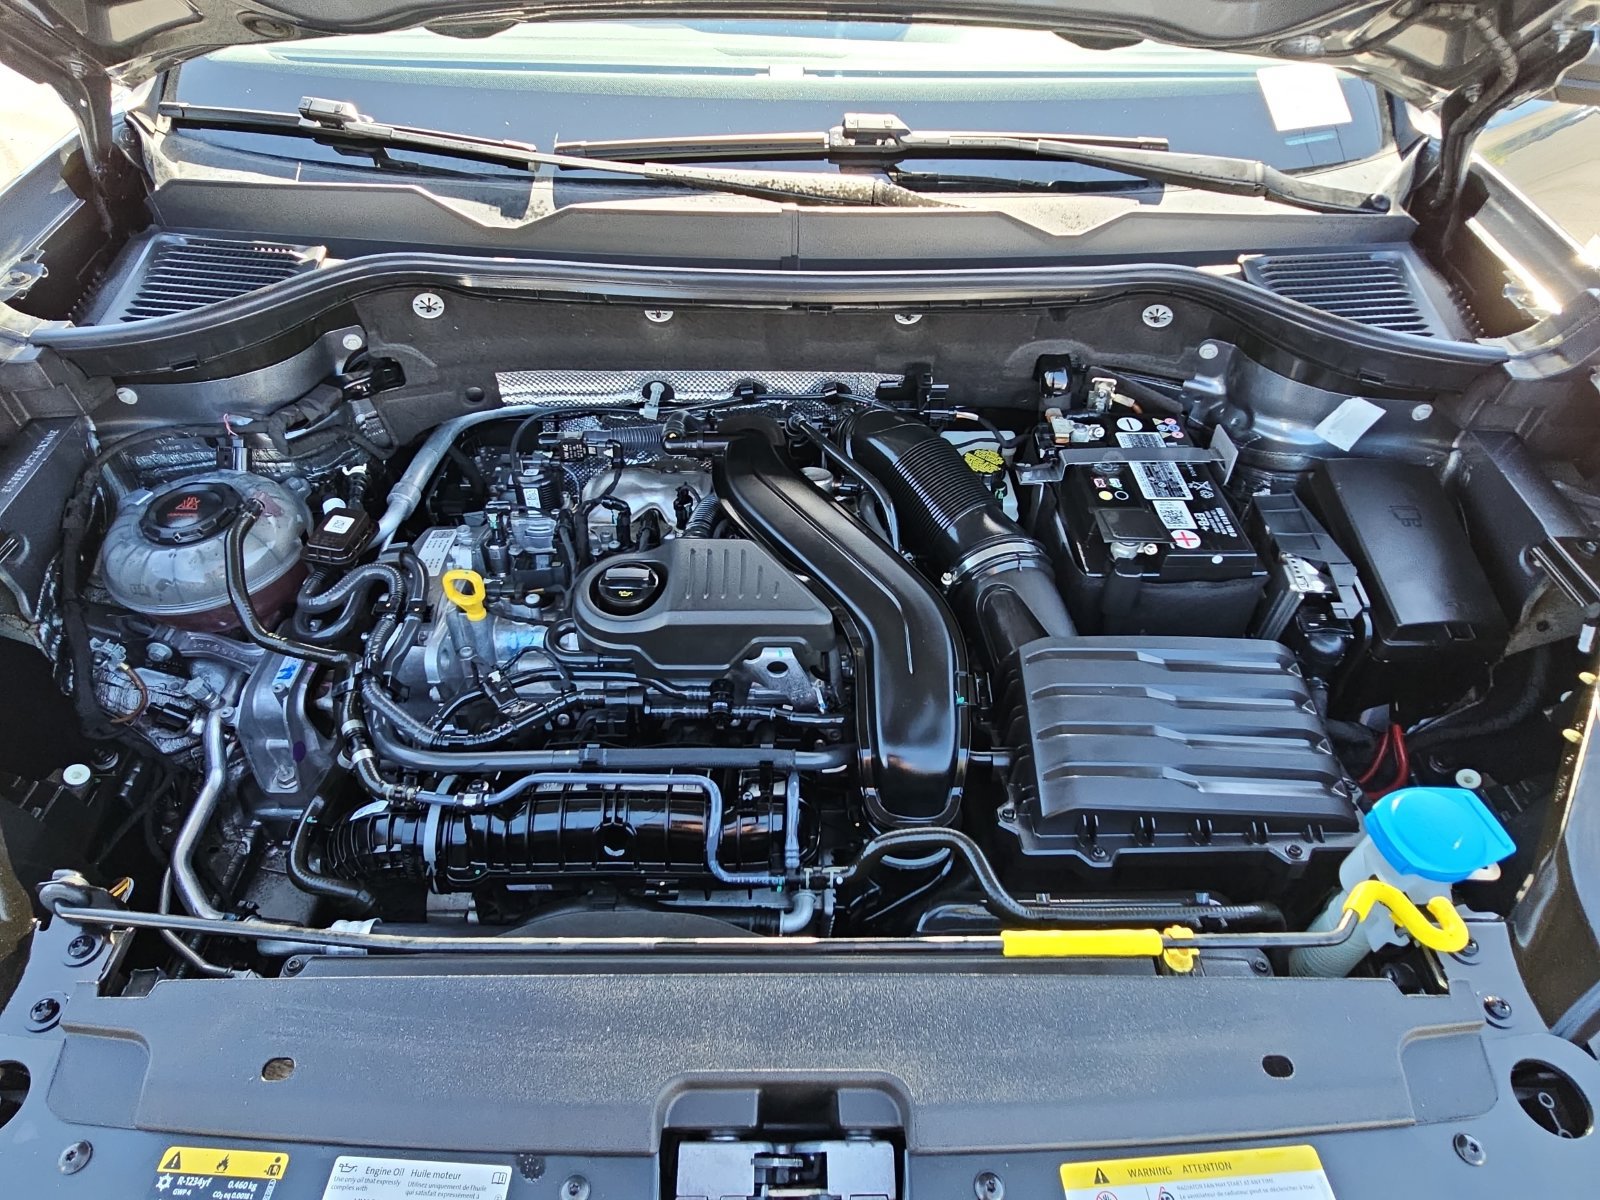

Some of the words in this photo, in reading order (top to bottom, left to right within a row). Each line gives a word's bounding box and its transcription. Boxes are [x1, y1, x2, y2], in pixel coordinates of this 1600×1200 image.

[1194, 512, 1210, 532] EFB+
[365, 1166, 392, 1178] Engine
[393, 1167, 405, 1176] Oil
[411, 1169, 431, 1179] Huile
[432, 1171, 462, 1180] moteur
[1127, 1166, 1173, 1178] WARNING
[1182, 1162, 1233, 1174] ATTENTION
[177, 1177, 213, 1189] R-1234yf
[228, 1180, 248, 1189] 0.460
[249, 1182, 258, 1191] kg
[330, 1184, 355, 1192] complies
[376, 1179, 401, 1187] expressly
[428, 1183, 462, 1191] uniquement
[405, 1189, 415, 1197] qui
